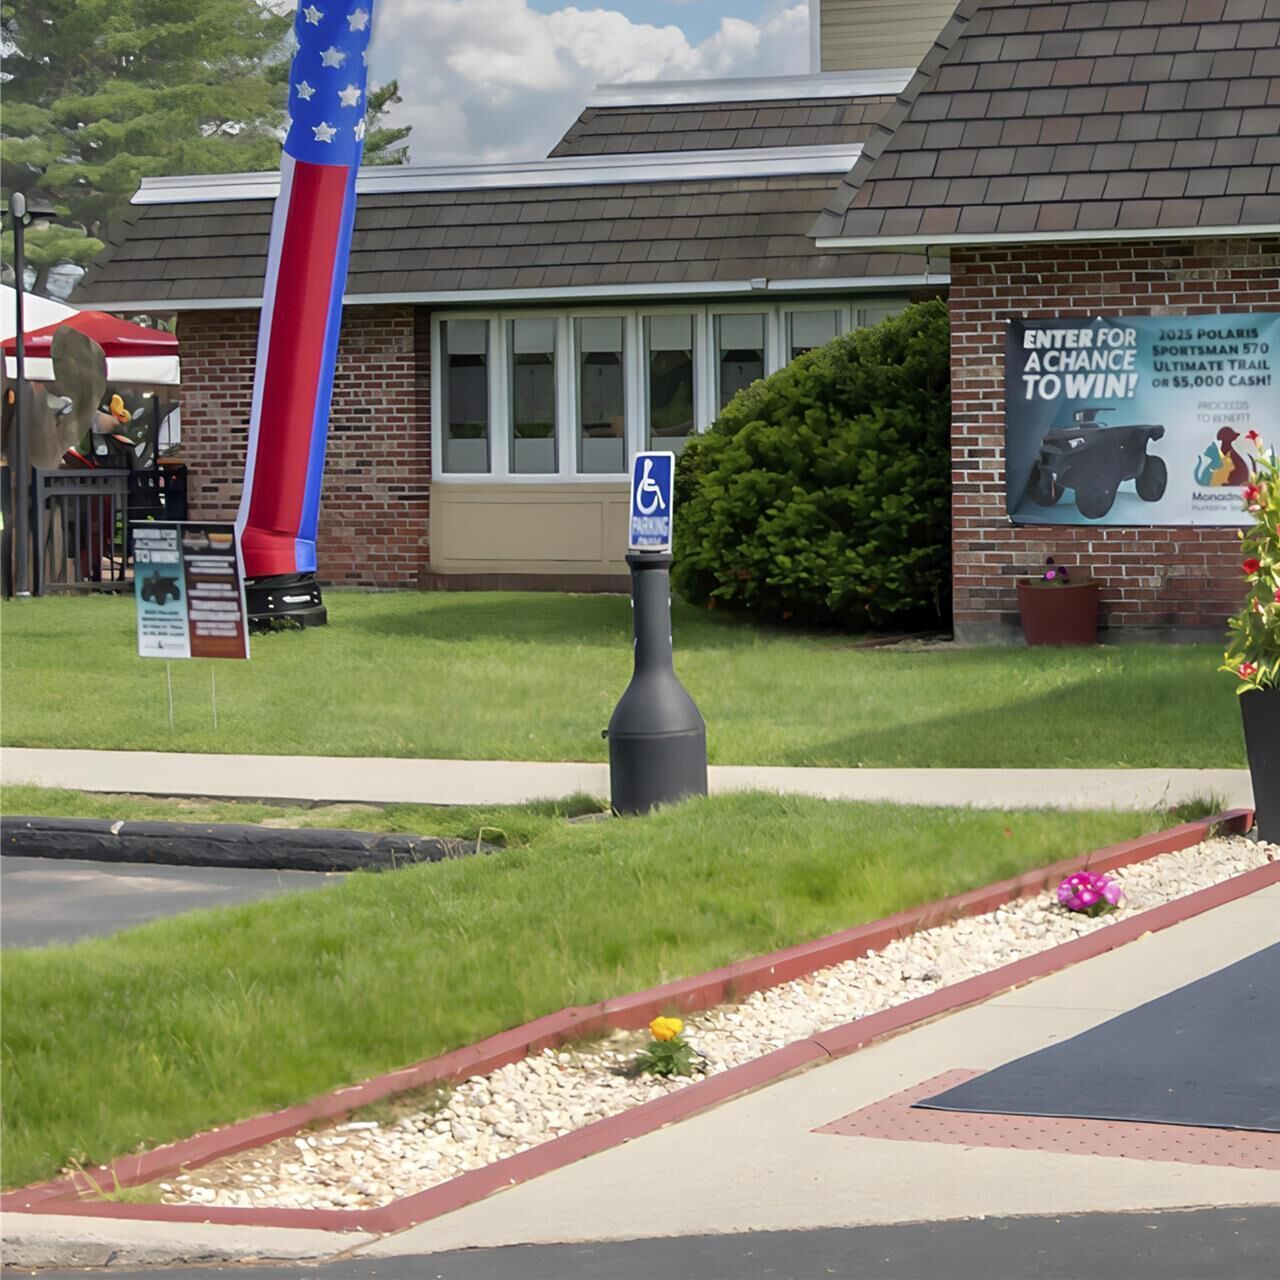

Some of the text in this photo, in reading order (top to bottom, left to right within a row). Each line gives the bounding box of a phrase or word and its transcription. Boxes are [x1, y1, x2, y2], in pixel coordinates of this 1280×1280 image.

[1023, 328, 1137, 349] ENTER FOR
[1159, 328, 1259, 340] 2025 POLARIS
[1152, 343, 1269, 356] SPORTSMAN 570
[1023, 349, 1138, 372] A CHANCE
[1153, 359, 1270, 372] ULTIMATE TRAIL
[1022, 373, 1139, 400] TO WIN!
[1173, 375, 1225, 388] $5,000
[1228, 374, 1271, 387] CASH!
